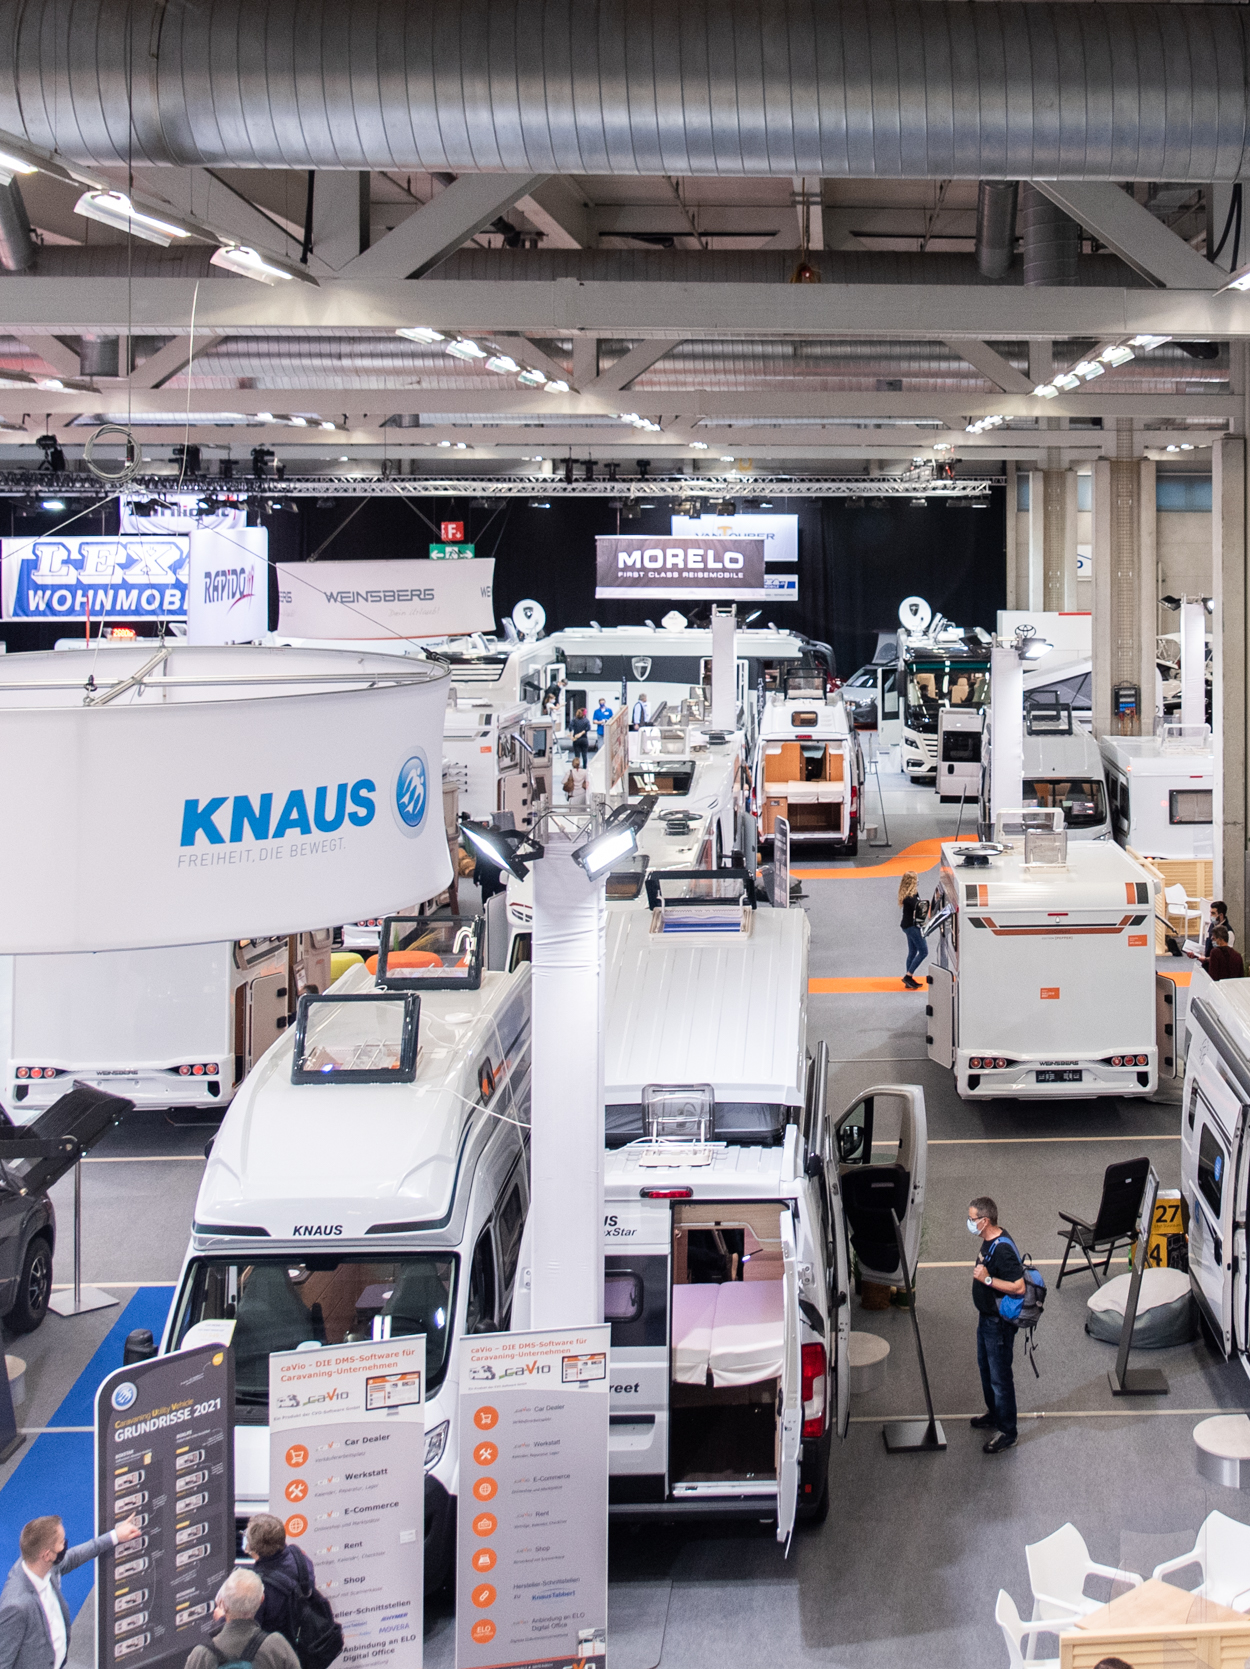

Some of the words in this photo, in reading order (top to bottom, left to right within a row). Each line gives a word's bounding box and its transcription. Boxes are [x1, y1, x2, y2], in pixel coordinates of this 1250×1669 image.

[31, 542, 189, 585] LEX
[617, 547, 744, 570] MORELO
[617, 571, 645, 579] FIRST
[648, 571, 679, 579] CLASS
[682, 571, 744, 579] REISEMOBILE
[324, 588, 435, 604] WEINSBERG
[180, 778, 377, 848] KNAUS
[177, 848, 256, 869] FREIHEIT,
[259, 845, 284, 862] DIE
[289, 836, 347, 859] BEWEGT.
[1155, 1205, 1180, 1223] 27
[292, 1224, 343, 1236] KNAUS
[471, 1346, 493, 1354] caVio
[518, 1339, 574, 1350] DMS-Software
[280, 1363, 306, 1373] caVio
[315, 1359, 332, 1368] DIE
[335, 1352, 400, 1366] DMS-Software
[402, 1348, 416, 1358] für
[470, 1348, 571, 1362] Caravaning-Unternehmen
[280, 1361, 398, 1383] Caravaning-Unternehmen
[114, 1407, 192, 1442] GRUNDRISSE
[193, 1397, 221, 1417] 2021
[115, 1411, 151, 1429] Caravaning
[151, 1404, 171, 1417] Utility
[171, 1398, 194, 1411] Vehicle
[344, 1438, 360, 1446] Car
[362, 1434, 391, 1444] Dealer
[533, 1439, 561, 1447] Werkstatt
[345, 1468, 388, 1481] Werkstatt
[533, 1474, 571, 1483] E-Commerce
[344, 1501, 400, 1515] E-Commerce
[344, 1542, 363, 1550] Rent
[344, 1575, 366, 1585] Shop
[343, 1640, 387, 1654] Anbindung
[401, 1634, 417, 1643] ELO
[343, 1651, 370, 1663] Digital
[372, 1648, 395, 1657] Office
